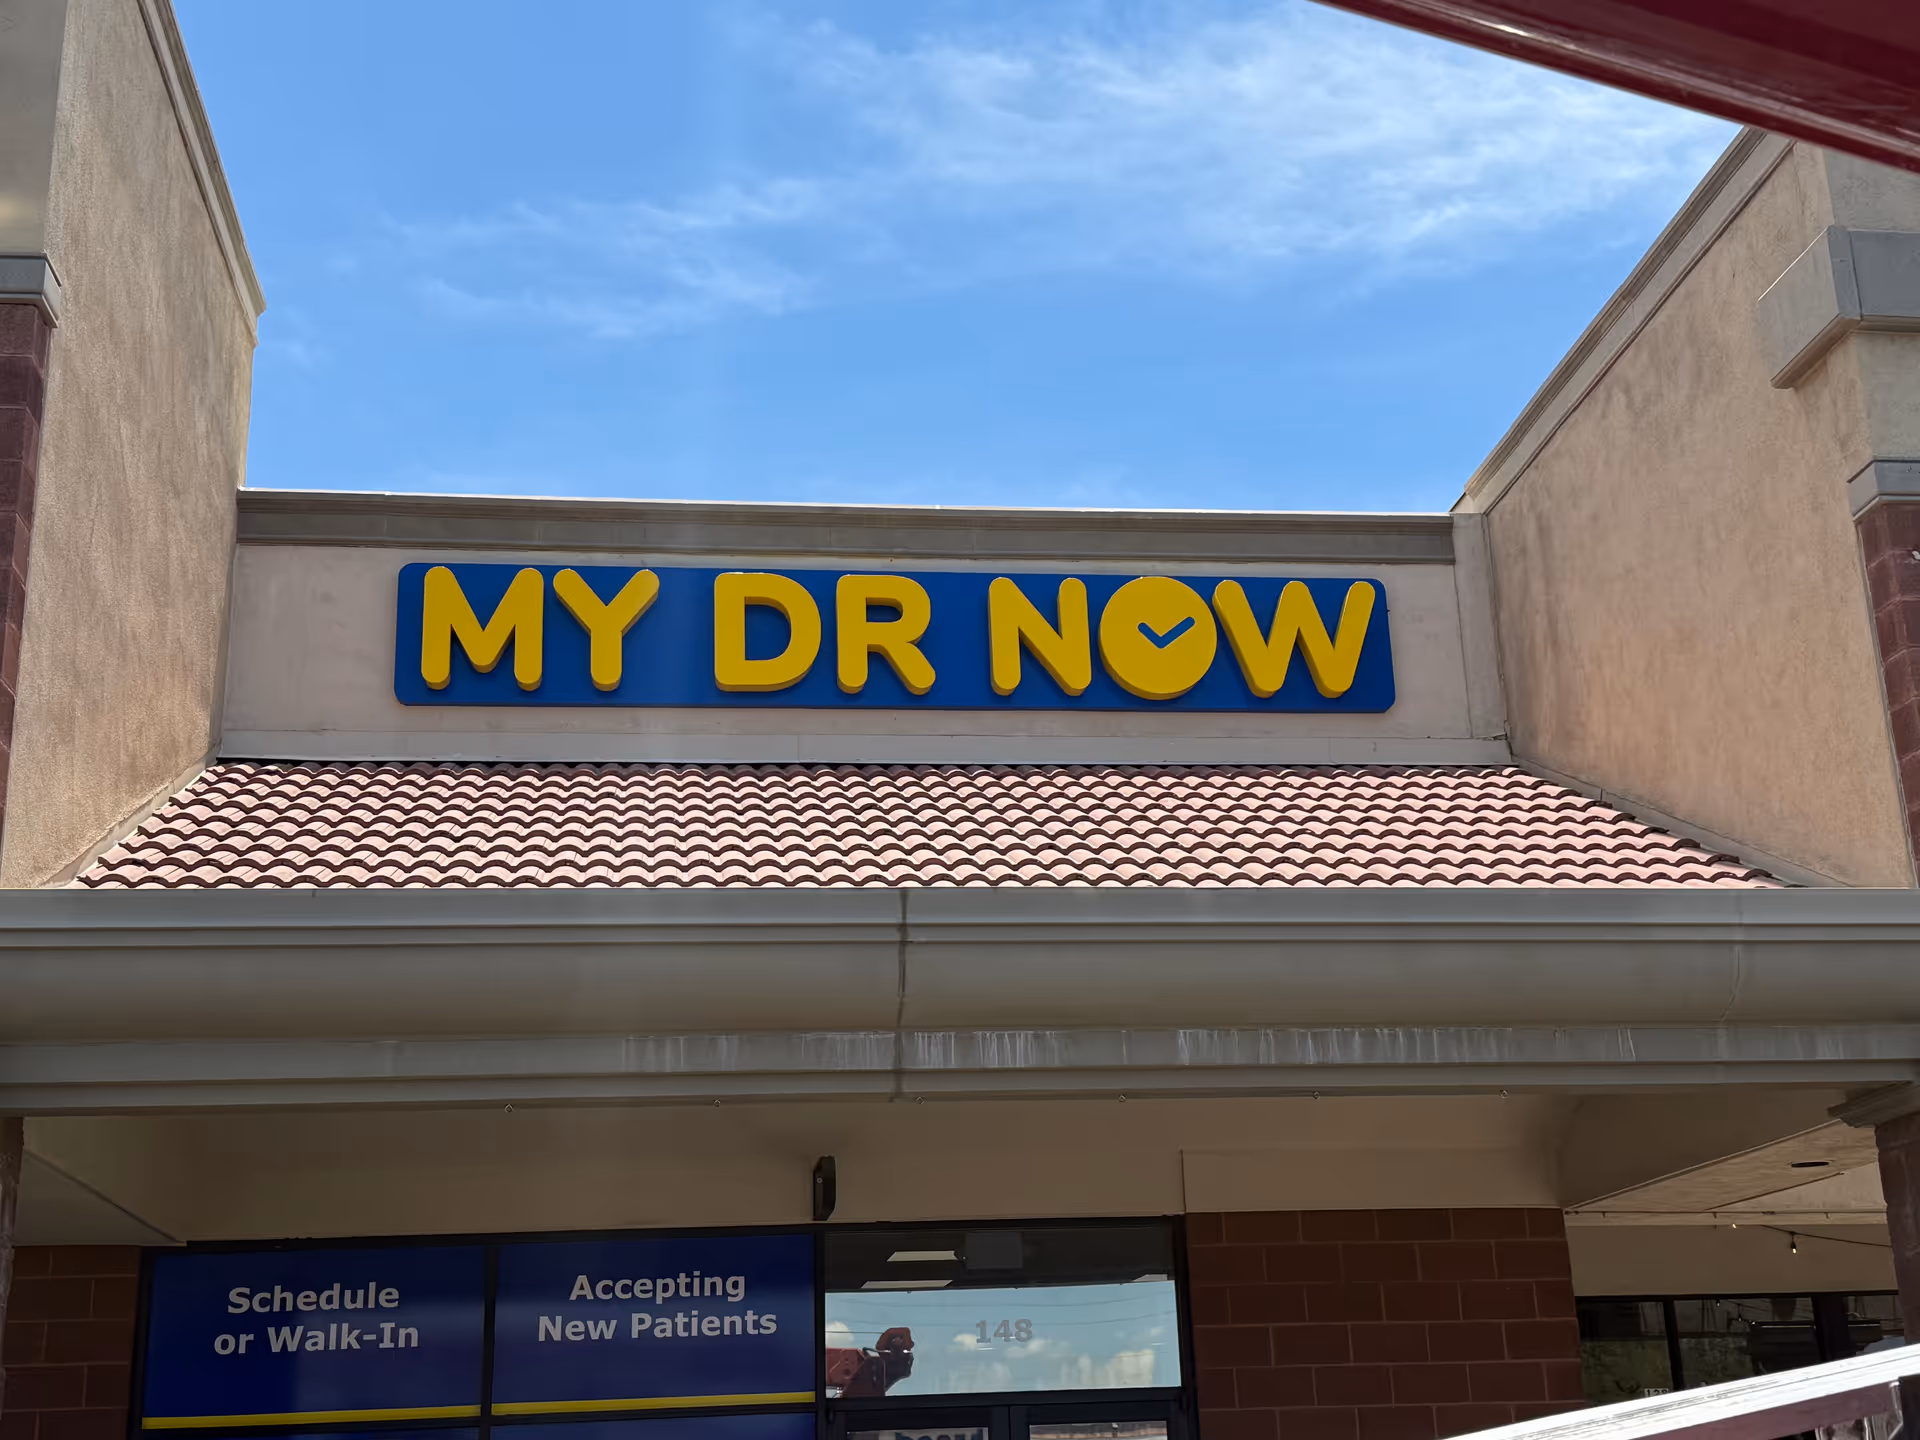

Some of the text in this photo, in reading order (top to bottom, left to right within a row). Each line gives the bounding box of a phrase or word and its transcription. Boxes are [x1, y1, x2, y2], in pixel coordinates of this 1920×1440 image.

[421, 565, 1377, 701] MY DR NOW
[227, 1282, 399, 1313] Schedule
[569, 1270, 745, 1305] Accepting
[214, 1322, 419, 1355] or Walk-In
[538, 1309, 778, 1342] New Patients
[975, 1318, 1033, 1344] 148
